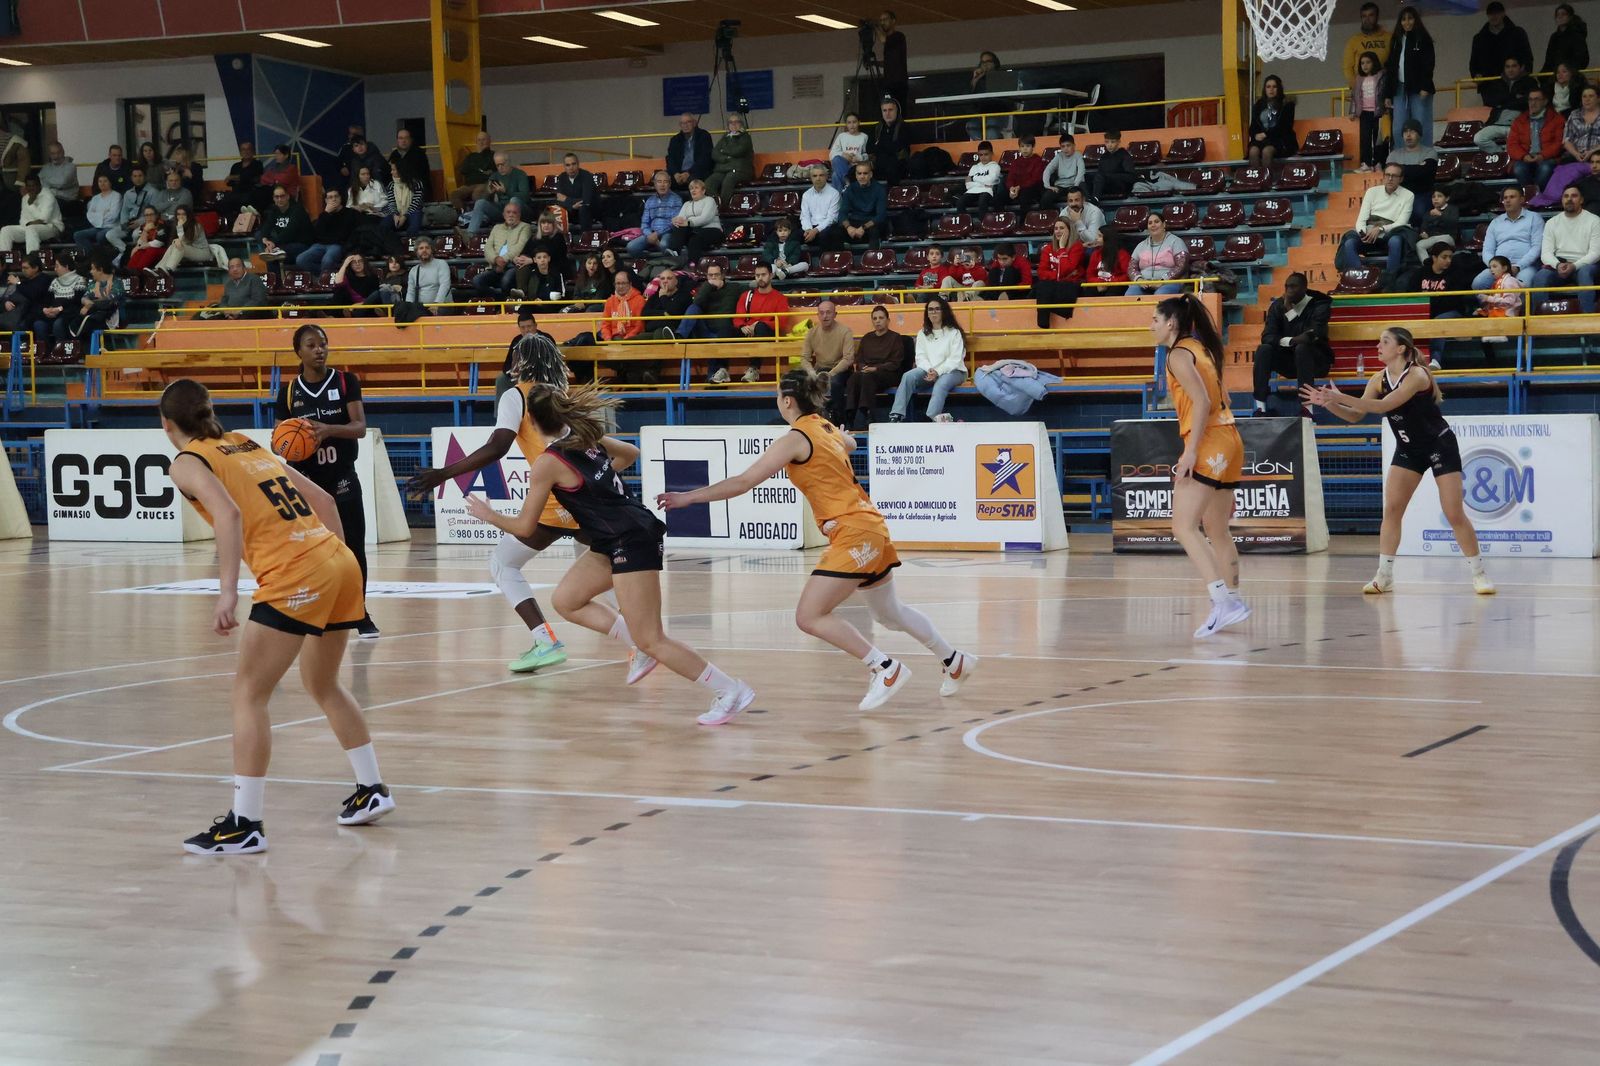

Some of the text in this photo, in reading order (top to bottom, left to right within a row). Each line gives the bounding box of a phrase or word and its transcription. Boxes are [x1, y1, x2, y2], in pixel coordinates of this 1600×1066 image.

[1201, 171, 1213, 181] 21
[902, 188, 909, 197] 7
[1172, 204, 1184, 214] 21
[951, 216, 960, 225] 11
[834, 253, 841, 263] 7
[876, 252, 883, 261] 9
[1398, 430, 1410, 443] 5
[739, 438, 760, 455] LUIS
[876, 445, 955, 454] E.S. CAMINO DE LA PLATA
[317, 446, 338, 465] 00
[892, 456, 903, 465] 980
[904, 456, 914, 465] 570
[915, 456, 925, 465] 021
[876, 467, 945, 476] Morales del Vino (Zamora)
[52, 453, 175, 519] G3C
[257, 475, 313, 521] 55
[752, 488, 797, 504] FERRERO
[1125, 489, 1174, 510] COMPI
[1233, 484, 1290, 510] SUEÑA
[877, 501, 957, 510] SERVICIO A DOMICILIO DE
[977, 503, 1035, 518] RepoSTAR
[53, 510, 91, 519] GIMNASIO
[136, 511, 175, 520] CRUCES
[898, 512, 905, 520] de
[1126, 509, 1144, 518] SIN
[1252, 509, 1291, 517] LIMITES
[456, 529, 473, 539] 980
[474, 529, 486, 539] 05
[486, 529, 498, 539] 85
[739, 522, 798, 540] ABOGADO
